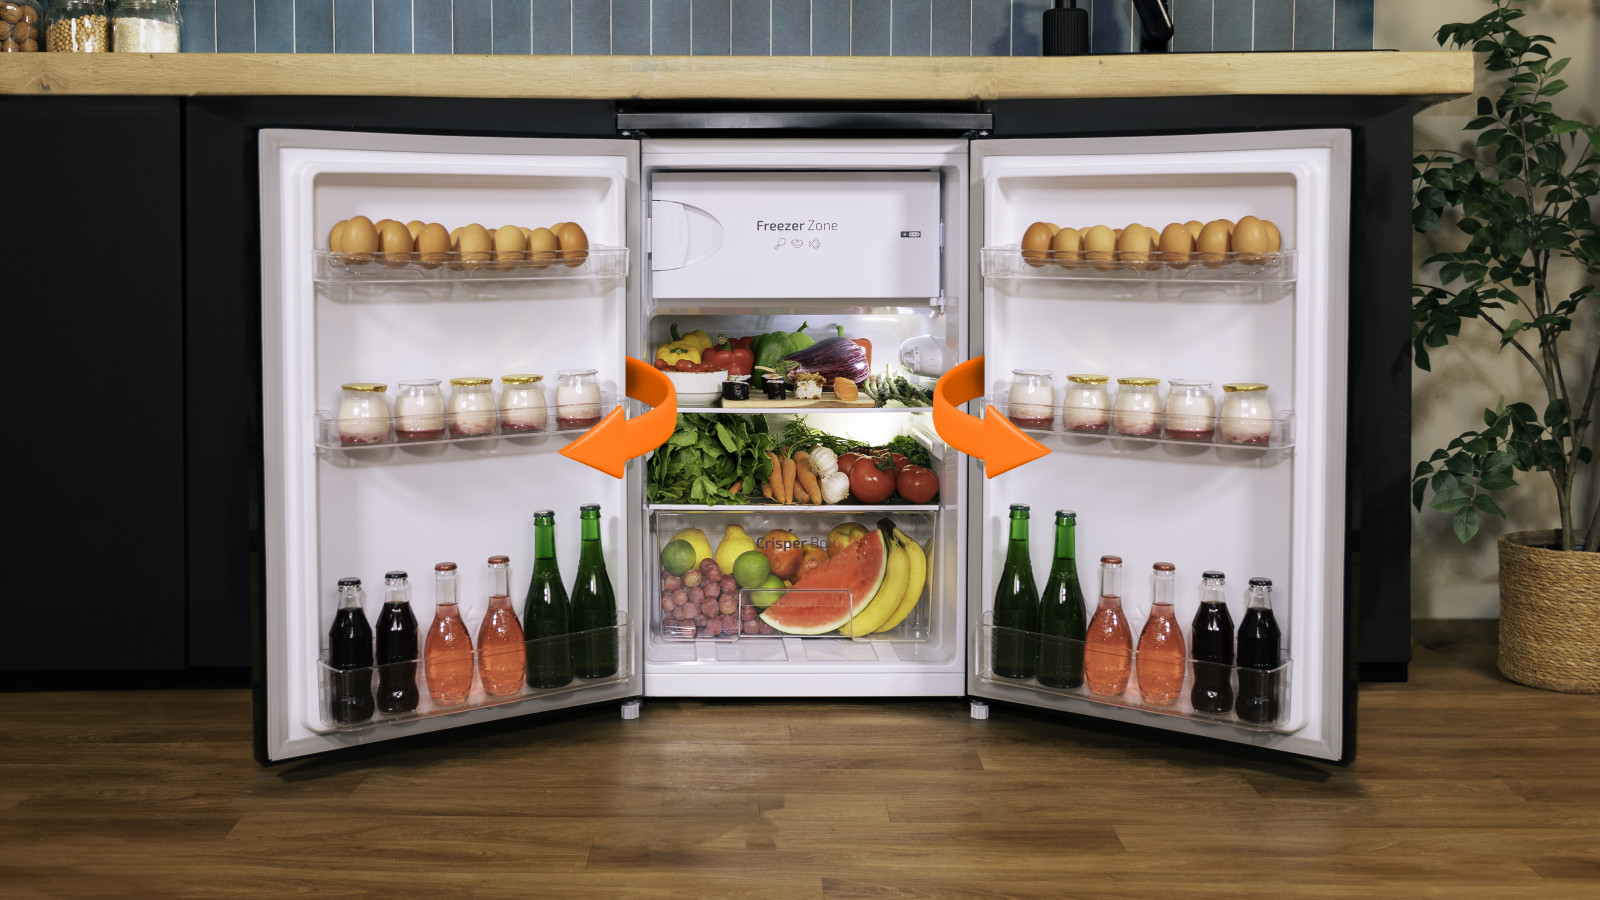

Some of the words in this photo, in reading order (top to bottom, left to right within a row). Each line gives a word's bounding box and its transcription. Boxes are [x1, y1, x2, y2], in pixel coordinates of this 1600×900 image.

[756, 220, 805, 231] Freezer
[807, 220, 838, 231] Zone
[756, 537, 807, 551] Crisper
[809, 536, 836, 549] Box
